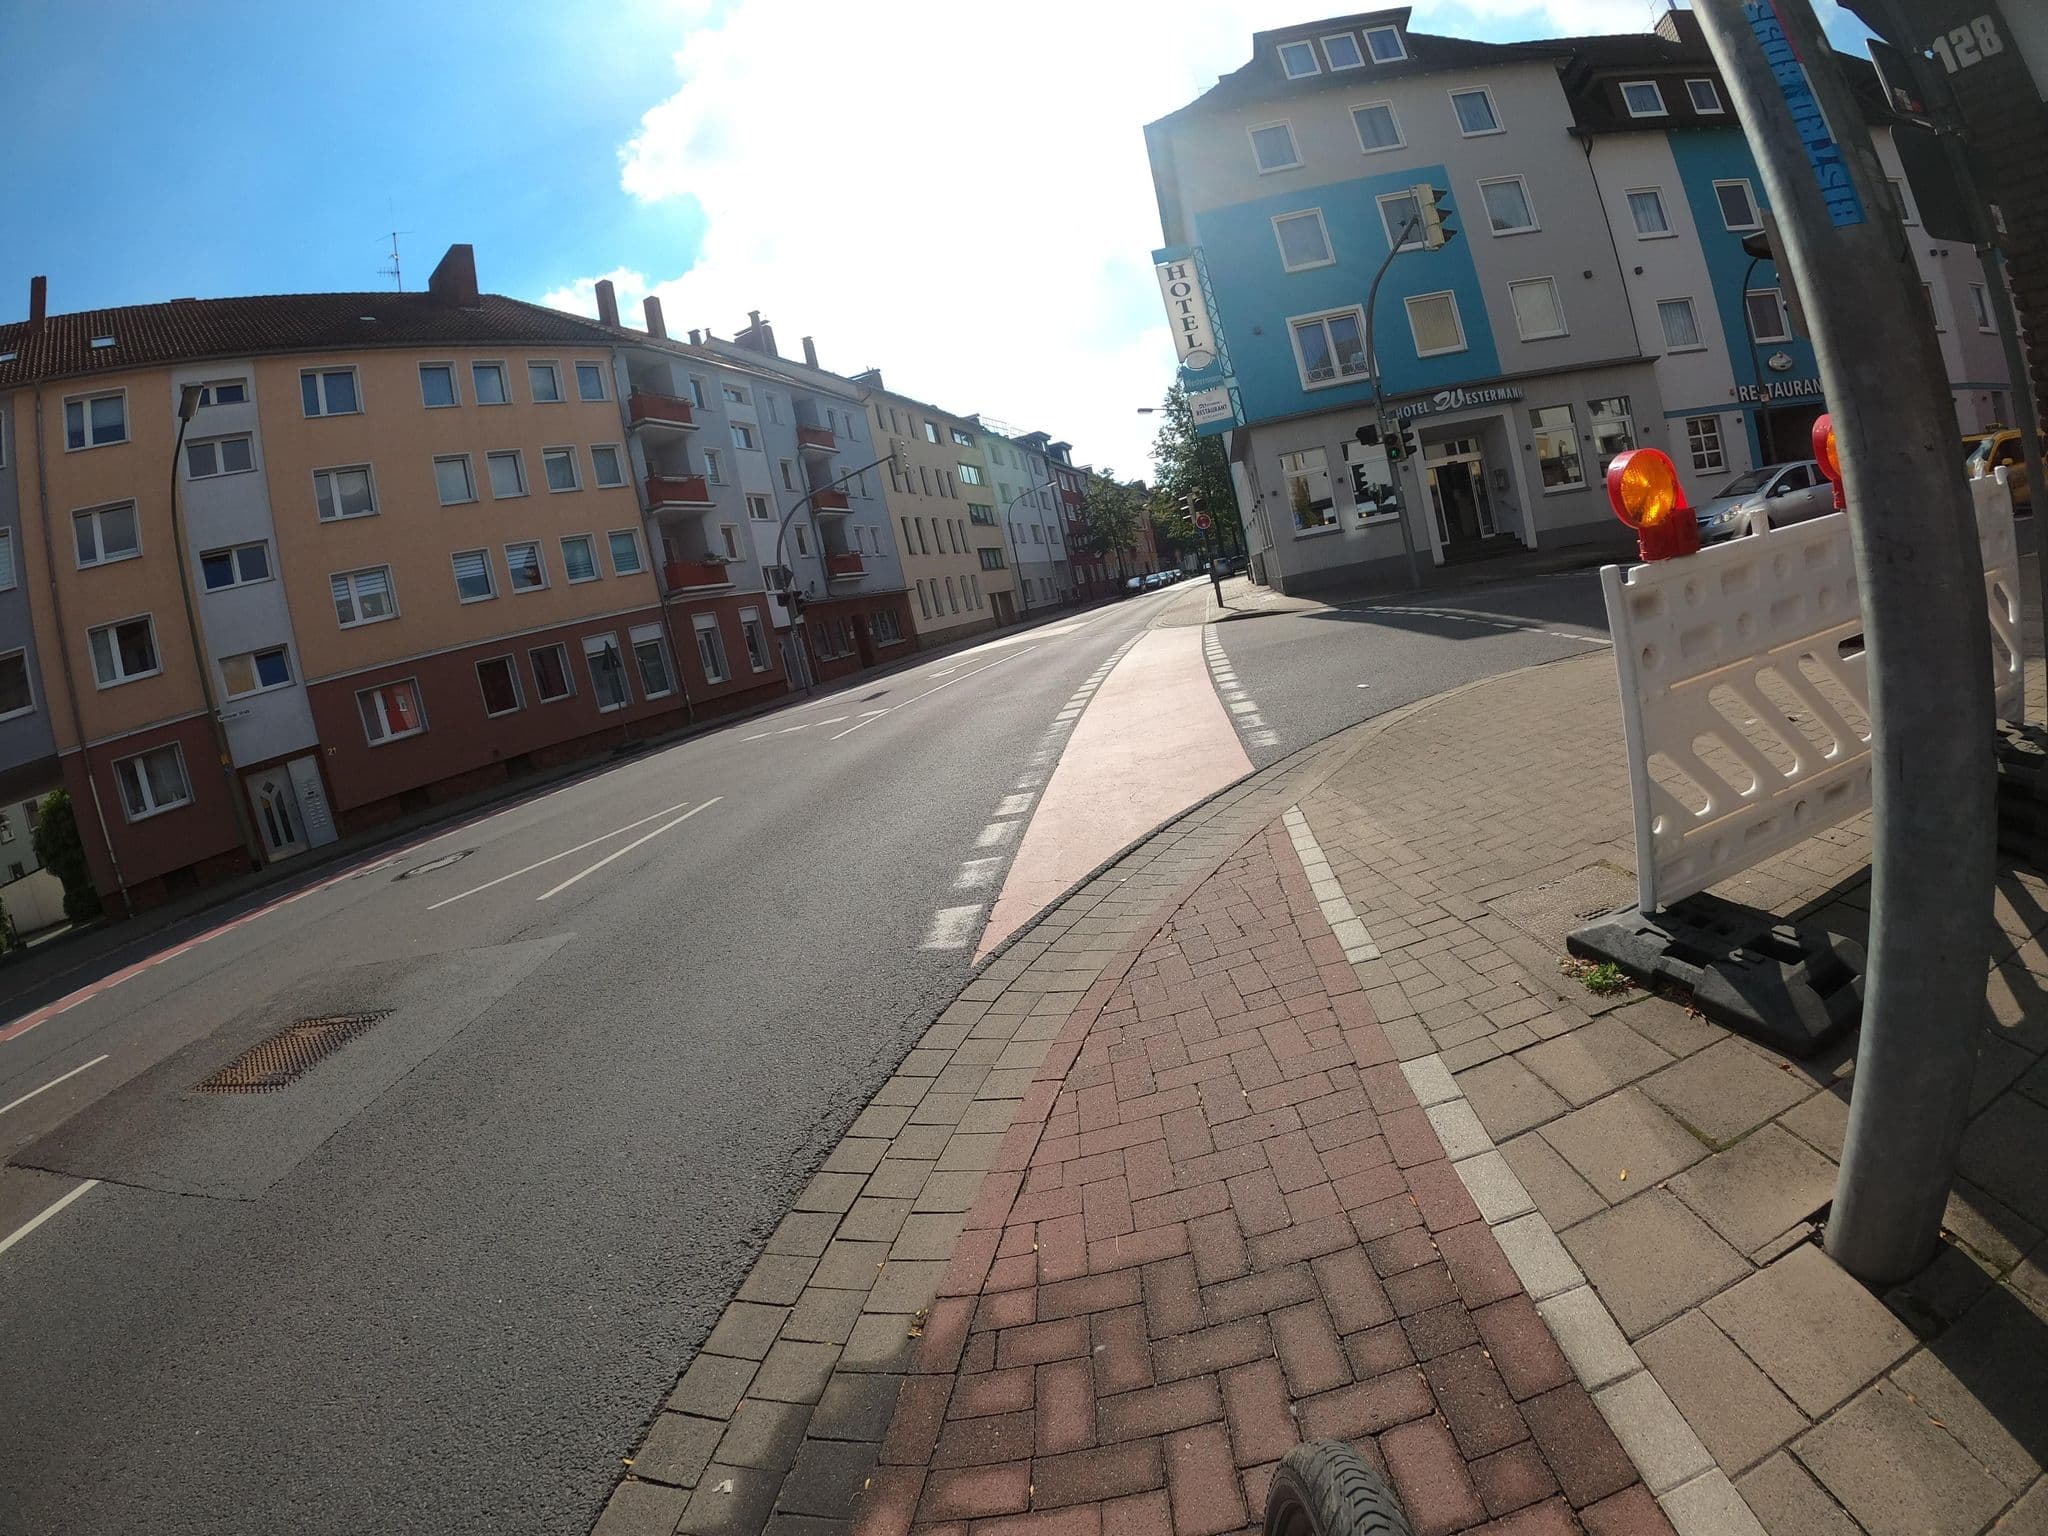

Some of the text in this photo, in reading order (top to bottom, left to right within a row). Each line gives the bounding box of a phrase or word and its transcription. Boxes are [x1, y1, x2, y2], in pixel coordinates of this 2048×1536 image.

[1932, 15, 2004, 74] 128
[1164, 264, 1203, 349] HOTEL
[1396, 401, 1430, 421] HOTEL
